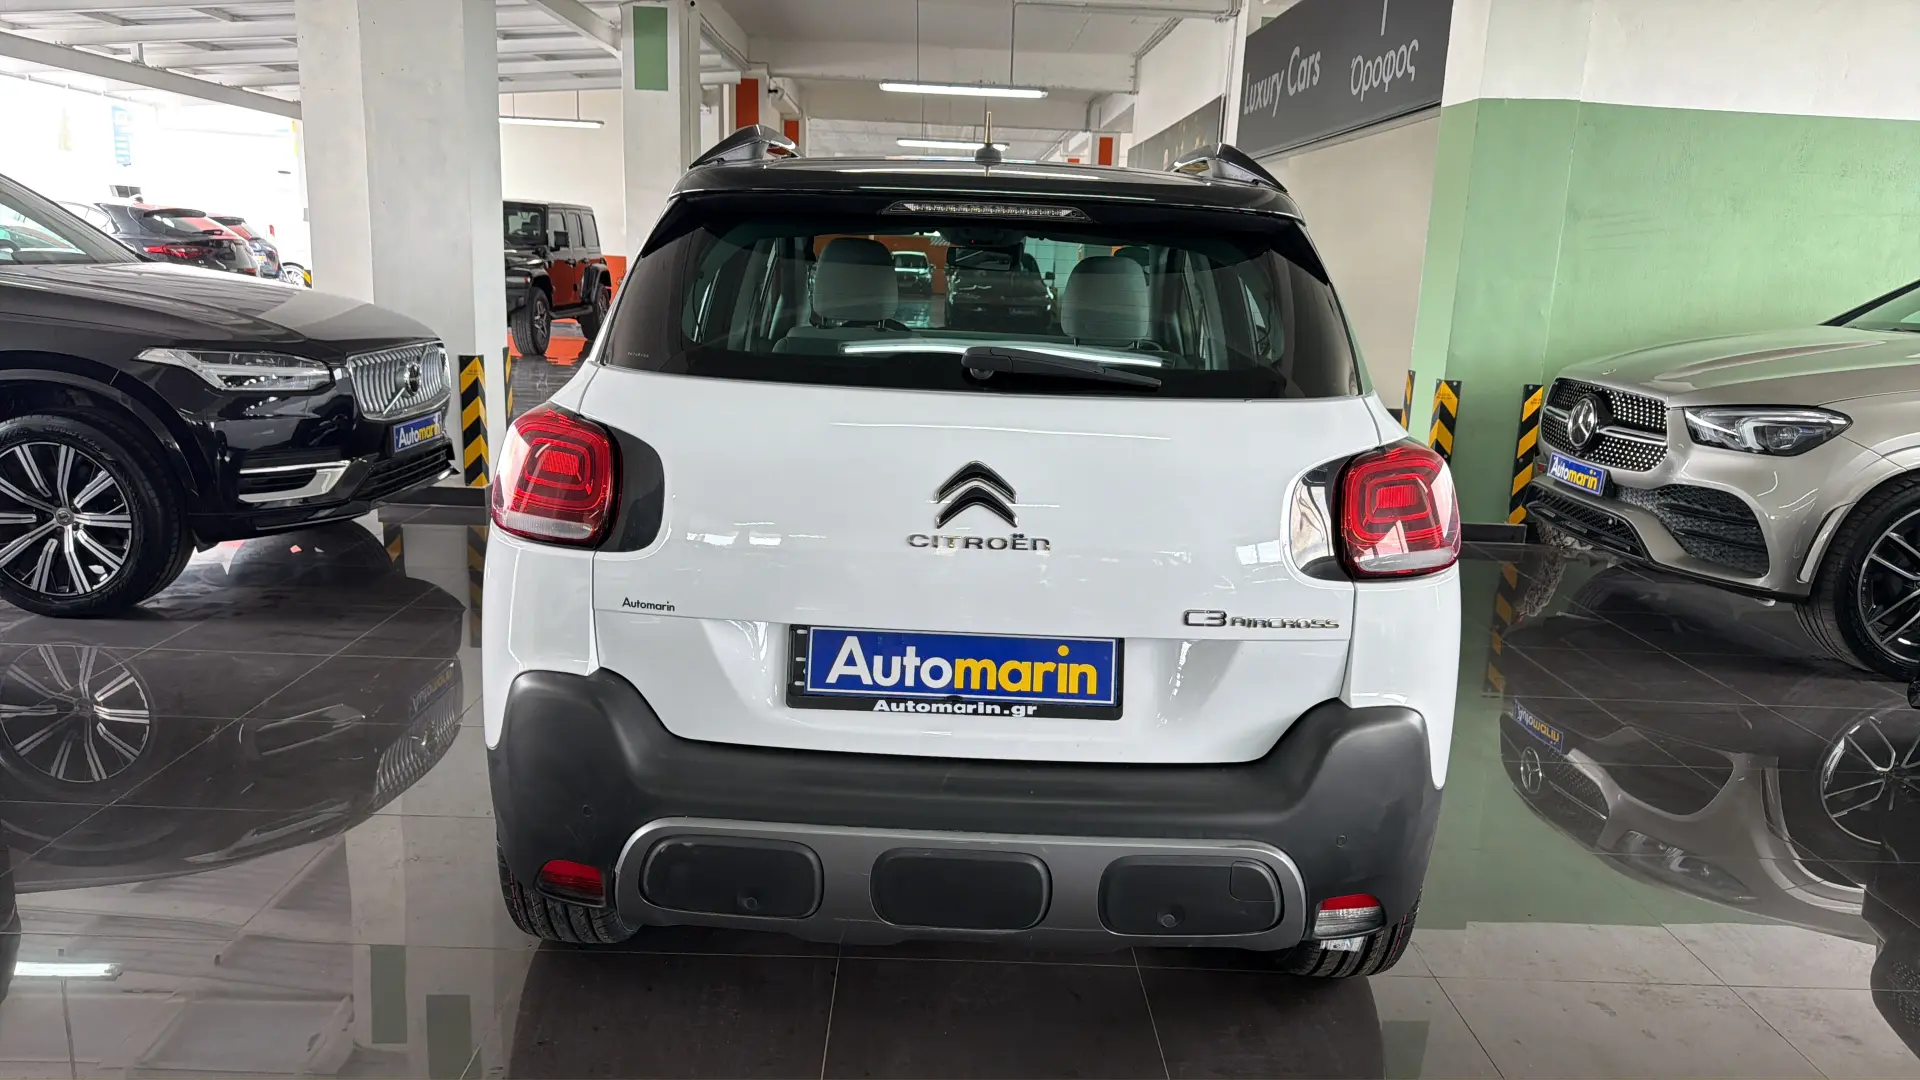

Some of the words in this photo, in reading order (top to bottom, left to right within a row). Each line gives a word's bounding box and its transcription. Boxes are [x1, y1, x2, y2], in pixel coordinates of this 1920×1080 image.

[1243, 70, 1285, 118] Luxury
[1287, 46, 1321, 97] Cars
[1350, 39, 1419, 102] Όροφος
[1550, 456, 1599, 490] Automarin
[906, 533, 1051, 551] CITROËN
[622, 597, 675, 612] Automarin
[1183, 609, 1228, 627] C3
[1230, 616, 1340, 630] AIRCROSS
[825, 635, 1098, 695] Automarin
[872, 699, 1039, 718] Automarin.gr
